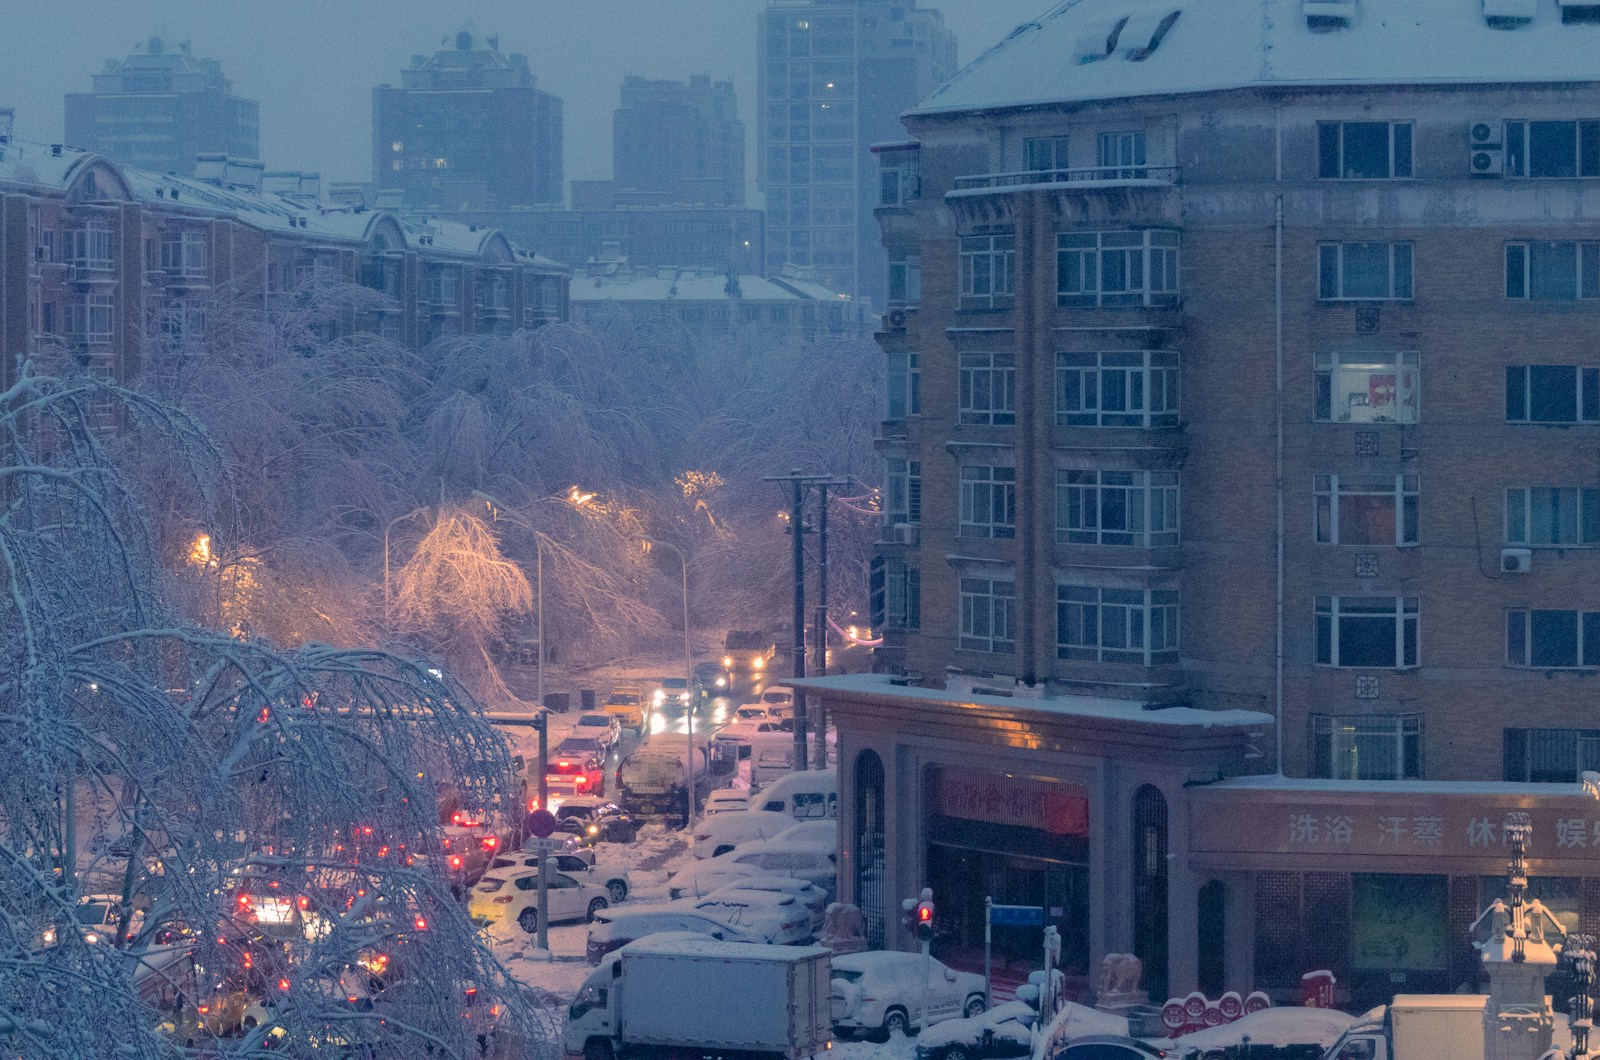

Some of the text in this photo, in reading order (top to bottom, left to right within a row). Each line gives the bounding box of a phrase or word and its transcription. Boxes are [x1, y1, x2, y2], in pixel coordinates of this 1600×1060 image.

[1290, 814, 1600, 849] 洗浴 汗蒸 休 娱
